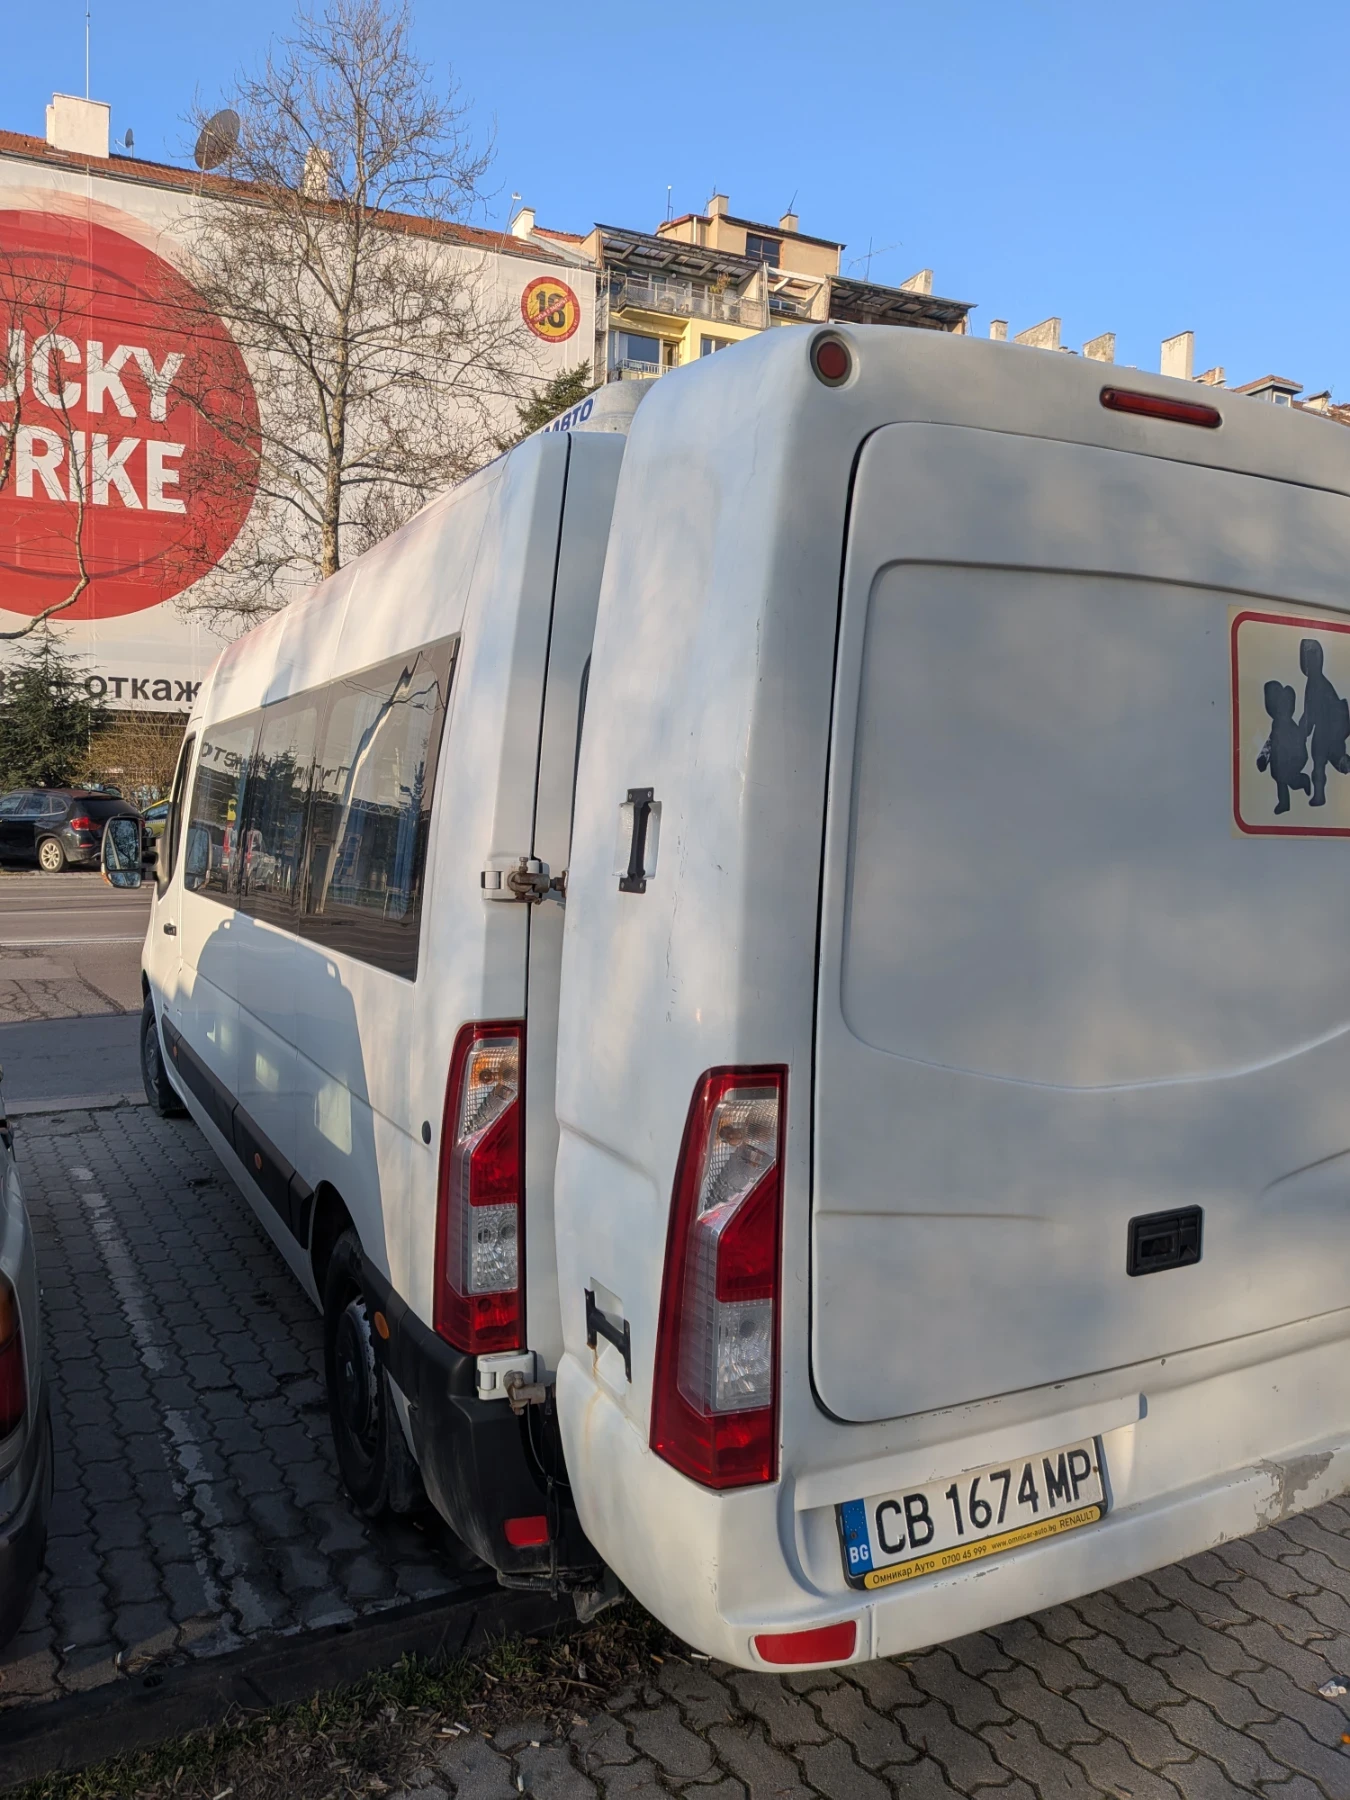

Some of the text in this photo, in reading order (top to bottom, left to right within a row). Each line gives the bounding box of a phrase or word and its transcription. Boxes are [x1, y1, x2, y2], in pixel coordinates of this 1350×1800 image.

[536, 290, 566, 328] 18
[874, 1449, 1091, 1555] CB 1674 MP
[849, 1544, 869, 1564] BG
[872, 1510, 1095, 1585] Омникар Ауто 0700 45 999 www.omnicar-auto.bg RENAULT
